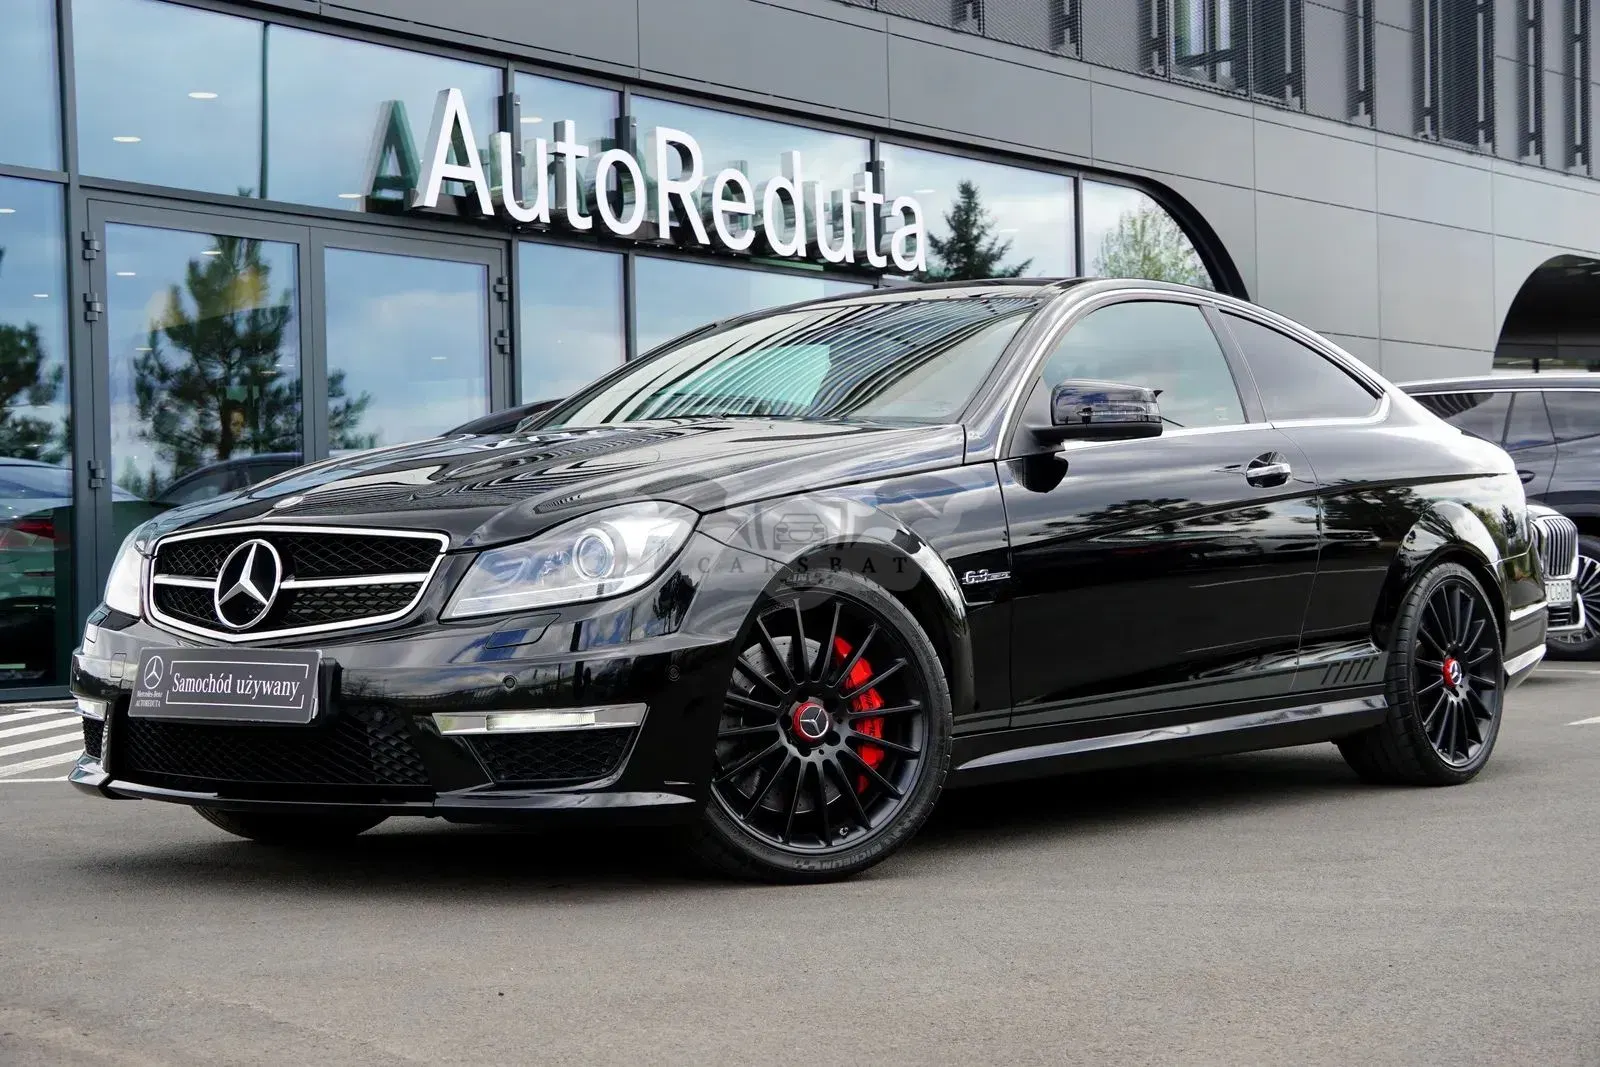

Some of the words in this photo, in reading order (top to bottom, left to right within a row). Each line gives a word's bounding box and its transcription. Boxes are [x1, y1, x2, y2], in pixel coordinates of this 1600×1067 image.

[411, 87, 927, 272] AutoReduta
[172, 672, 232, 694] Samochód
[236, 674, 300, 701] używany
